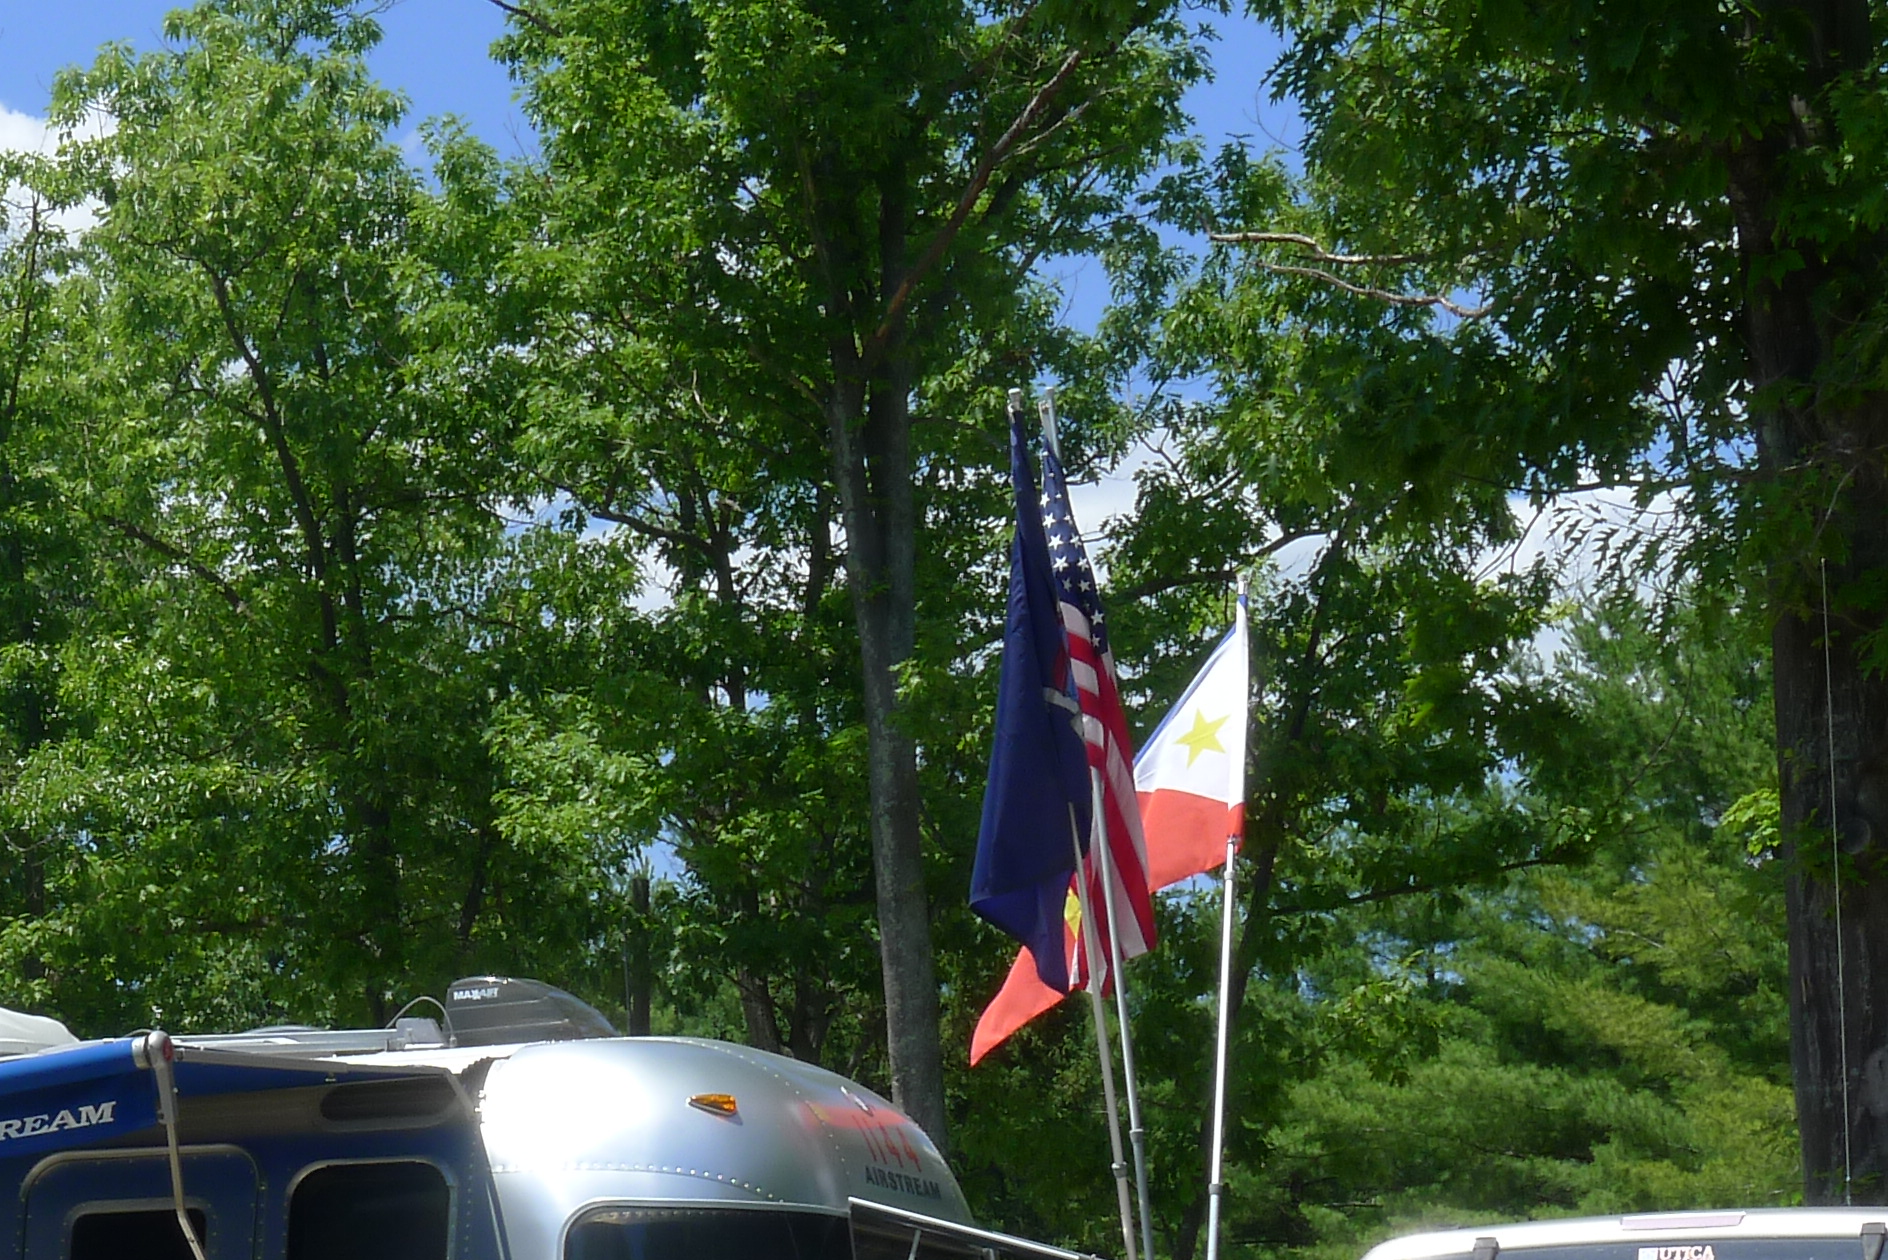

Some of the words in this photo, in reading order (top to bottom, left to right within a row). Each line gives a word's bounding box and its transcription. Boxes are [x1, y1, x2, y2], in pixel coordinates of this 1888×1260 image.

[851, 1114, 922, 1173] 1144
[864, 1165, 942, 1200] AIRSTREAM
[1659, 1244, 1715, 1260] UTICA
